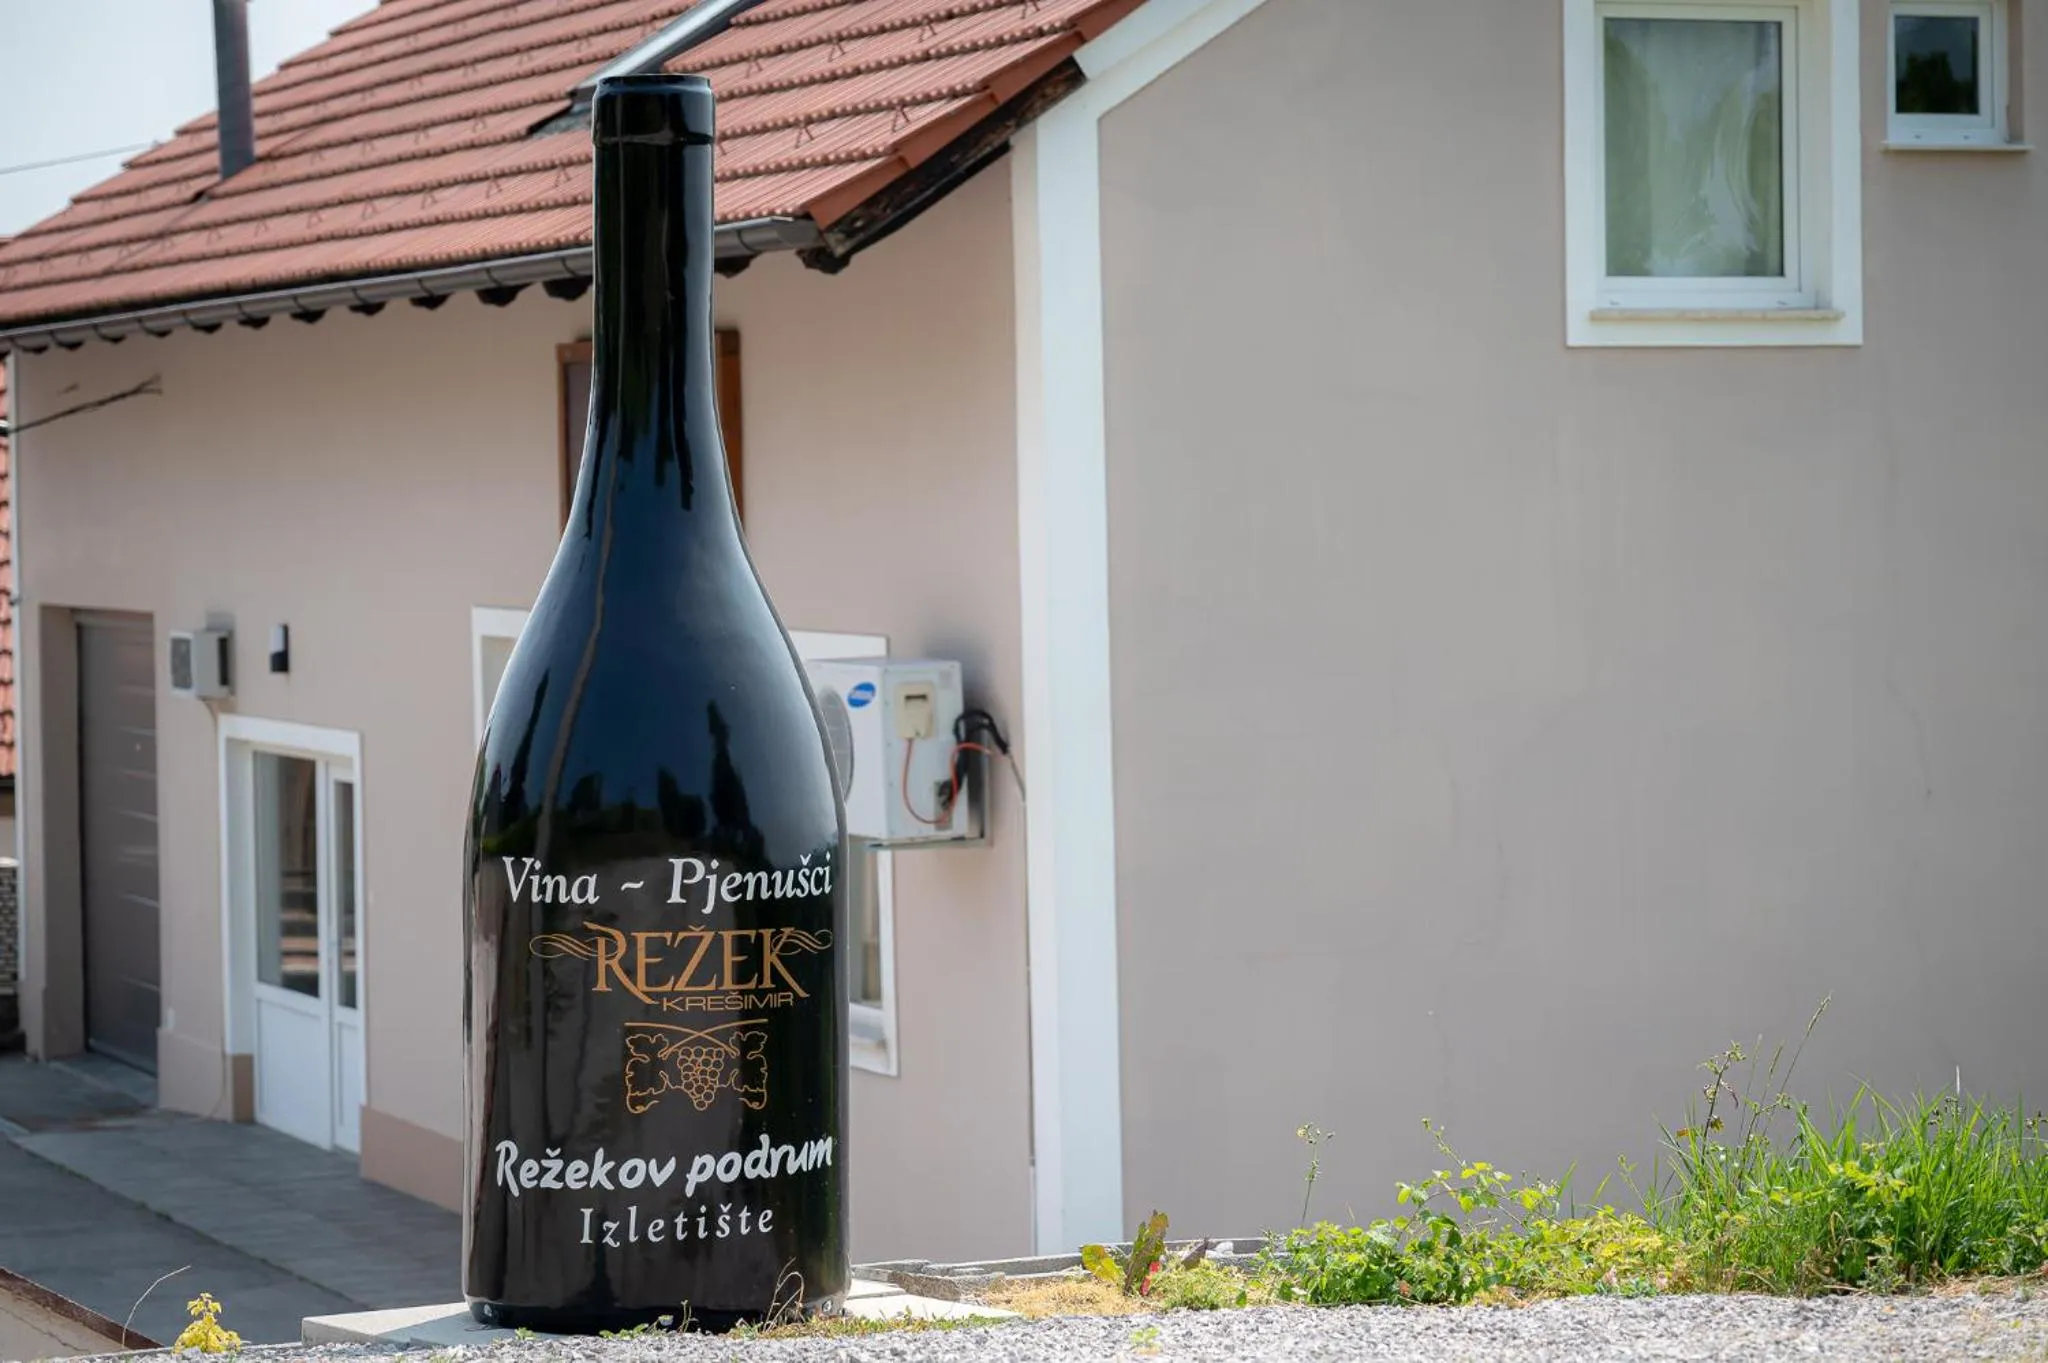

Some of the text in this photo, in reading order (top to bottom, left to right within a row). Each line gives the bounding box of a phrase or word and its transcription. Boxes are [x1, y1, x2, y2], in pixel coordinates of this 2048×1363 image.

[502, 856, 599, 904] Vina
[667, 853, 832, 913] Pjenušci
[583, 921, 810, 1004] REŽEK
[662, 991, 793, 1012] KREŠIMIR
[496, 1133, 833, 1197] Režekov podrum
[580, 1202, 774, 1248] Izletište
